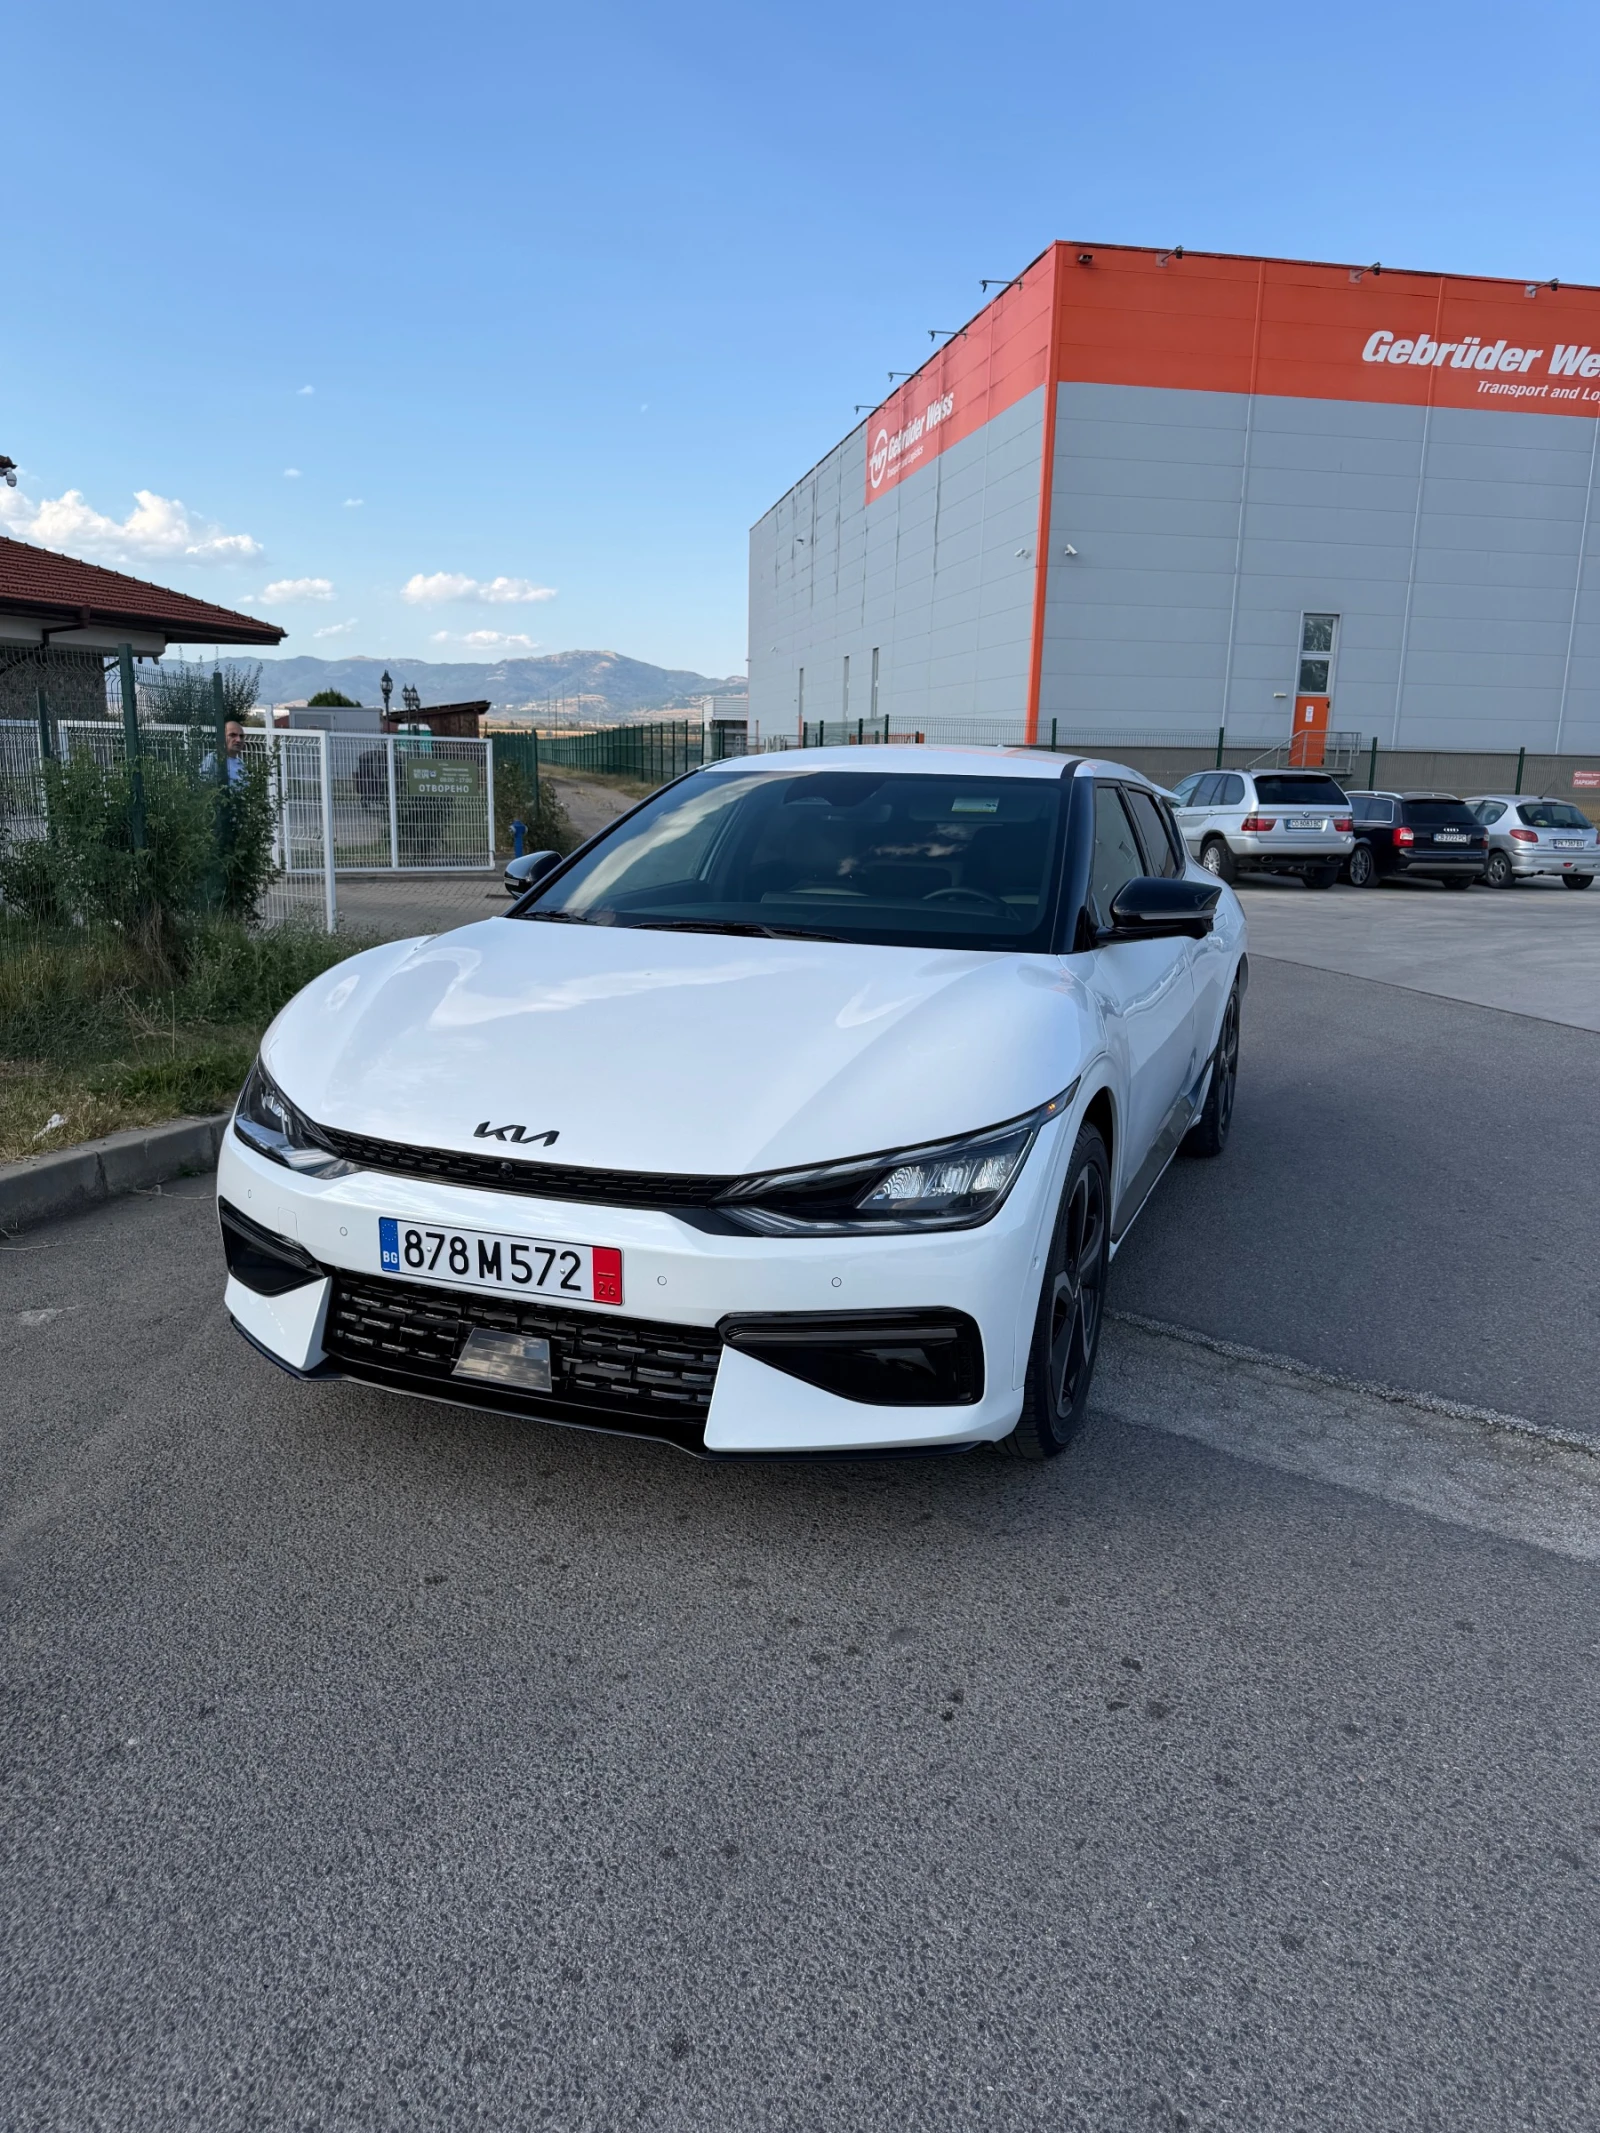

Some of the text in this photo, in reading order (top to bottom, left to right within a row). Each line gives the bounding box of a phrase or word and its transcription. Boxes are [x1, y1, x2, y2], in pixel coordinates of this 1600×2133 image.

[1362, 330, 1600, 378] Gebrüder We
[926, 391, 954, 431] Weiss
[1477, 380, 1600, 404] Transport and Lo
[419, 785, 469, 793] ОТВОРЕНО
[383, 1250, 398, 1264] BG
[598, 1281, 616, 1296] 26
